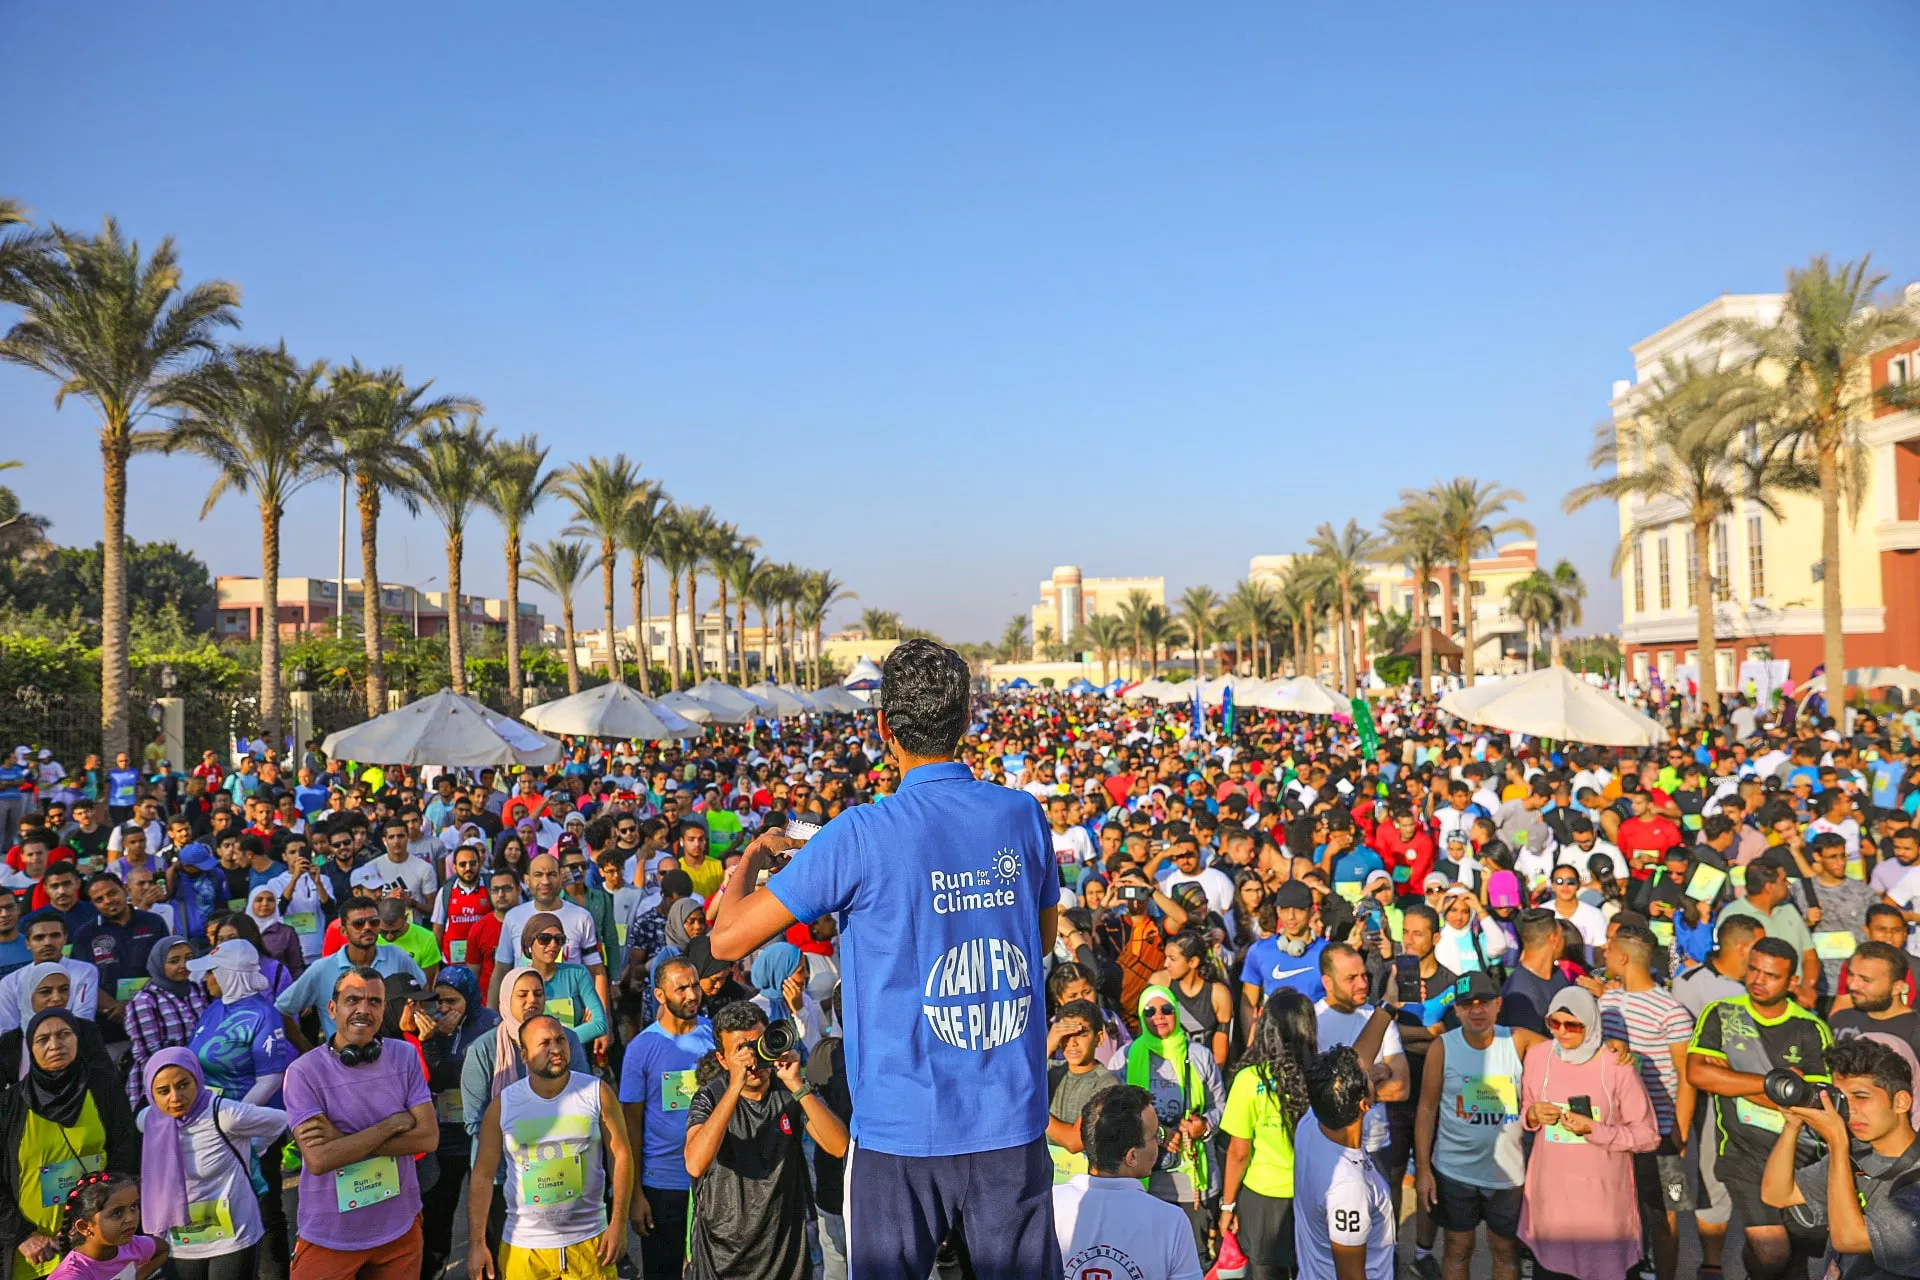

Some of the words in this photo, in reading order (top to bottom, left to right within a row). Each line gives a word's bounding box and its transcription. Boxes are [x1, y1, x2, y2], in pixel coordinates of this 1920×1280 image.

[931, 869, 974, 892] Run
[976, 870, 989, 878] for
[977, 878, 991, 886] the
[933, 888, 1015, 915] Climate
[924, 954, 944, 997] I
[938, 938, 986, 998] RAN
[989, 938, 1031, 991] FOR
[923, 1003, 968, 1049] THE
[968, 995, 1032, 1051] PLANET
[353, 1179, 369, 1187] Run
[354, 1181, 382, 1193] Climate
[537, 1181, 565, 1189] Climate
[1335, 1209, 1360, 1232] 92
[1070, 1252, 1091, 1270] THE
[1096, 1248, 1141, 1280] BRITISH
